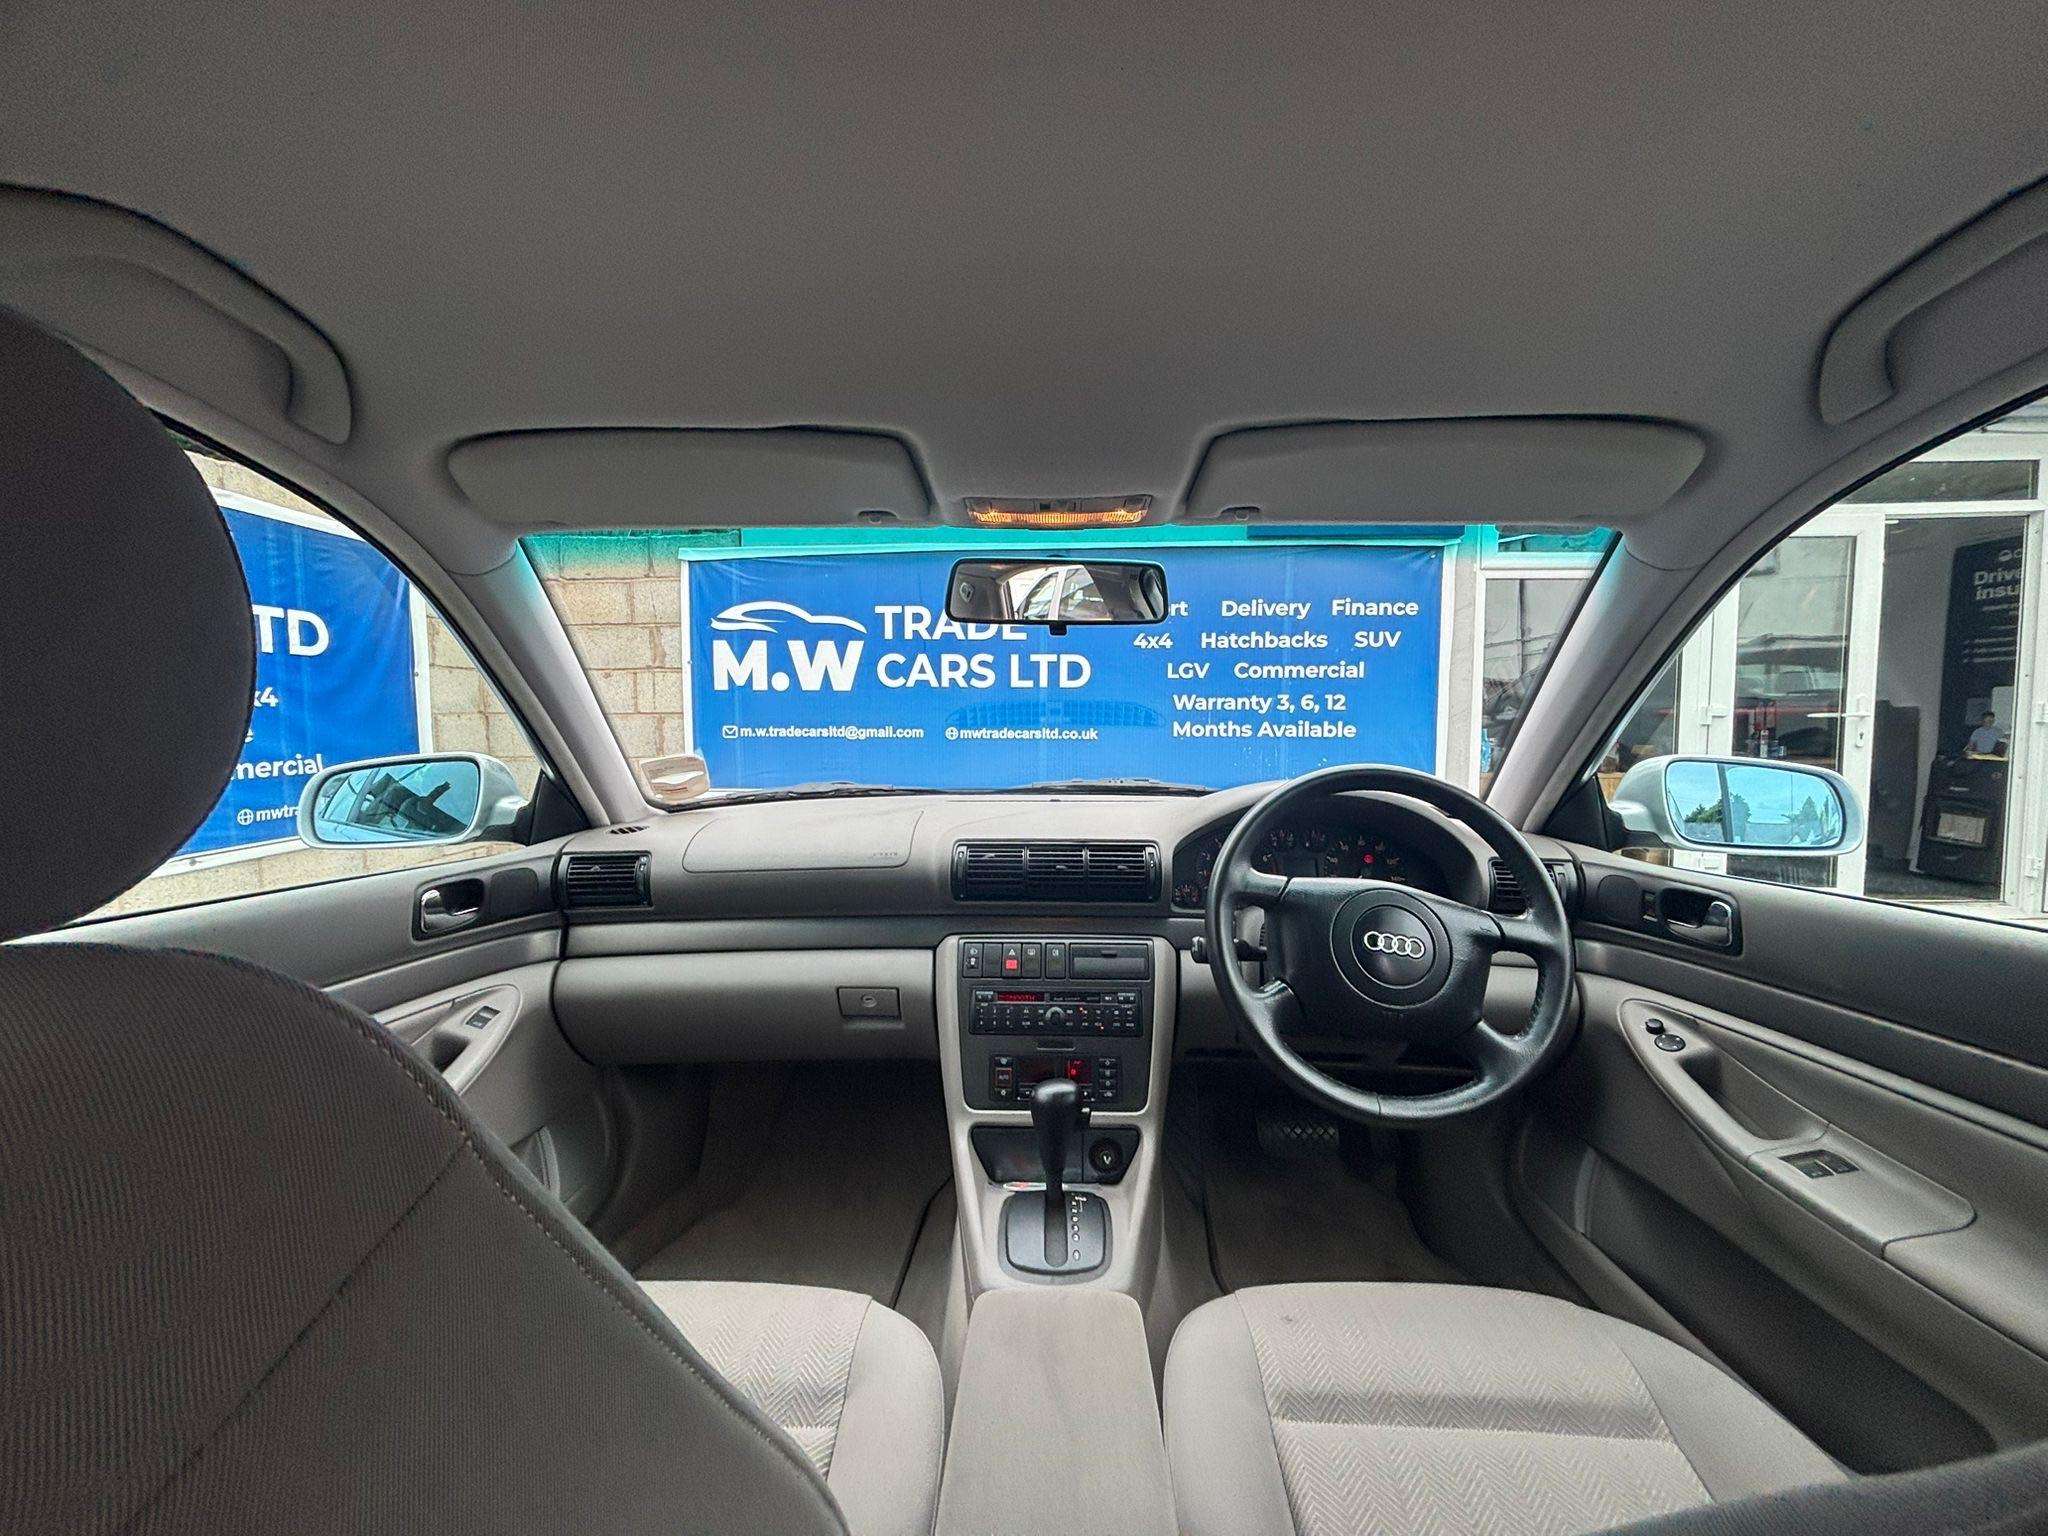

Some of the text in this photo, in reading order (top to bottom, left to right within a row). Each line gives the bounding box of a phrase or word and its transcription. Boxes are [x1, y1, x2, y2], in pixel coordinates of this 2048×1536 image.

[1169, 597, 1419, 620] rt Delivery Finance
[251, 604, 330, 657] TD
[1133, 630, 1402, 649] 4x4 Hatchbacks SUV
[712, 639, 865, 692] M.W
[876, 652, 1092, 689] CARS LTD
[1167, 660, 1365, 679] LGV Commercial
[1173, 694, 1346, 714] Warranty 3, 6, 12
[740, 725, 1098, 741] m.w.tradecarsltd@gmail.com mwtradecarsltd.co.uk
[1173, 720, 1357, 738] Months Available
[231, 753, 323, 780] mercial
